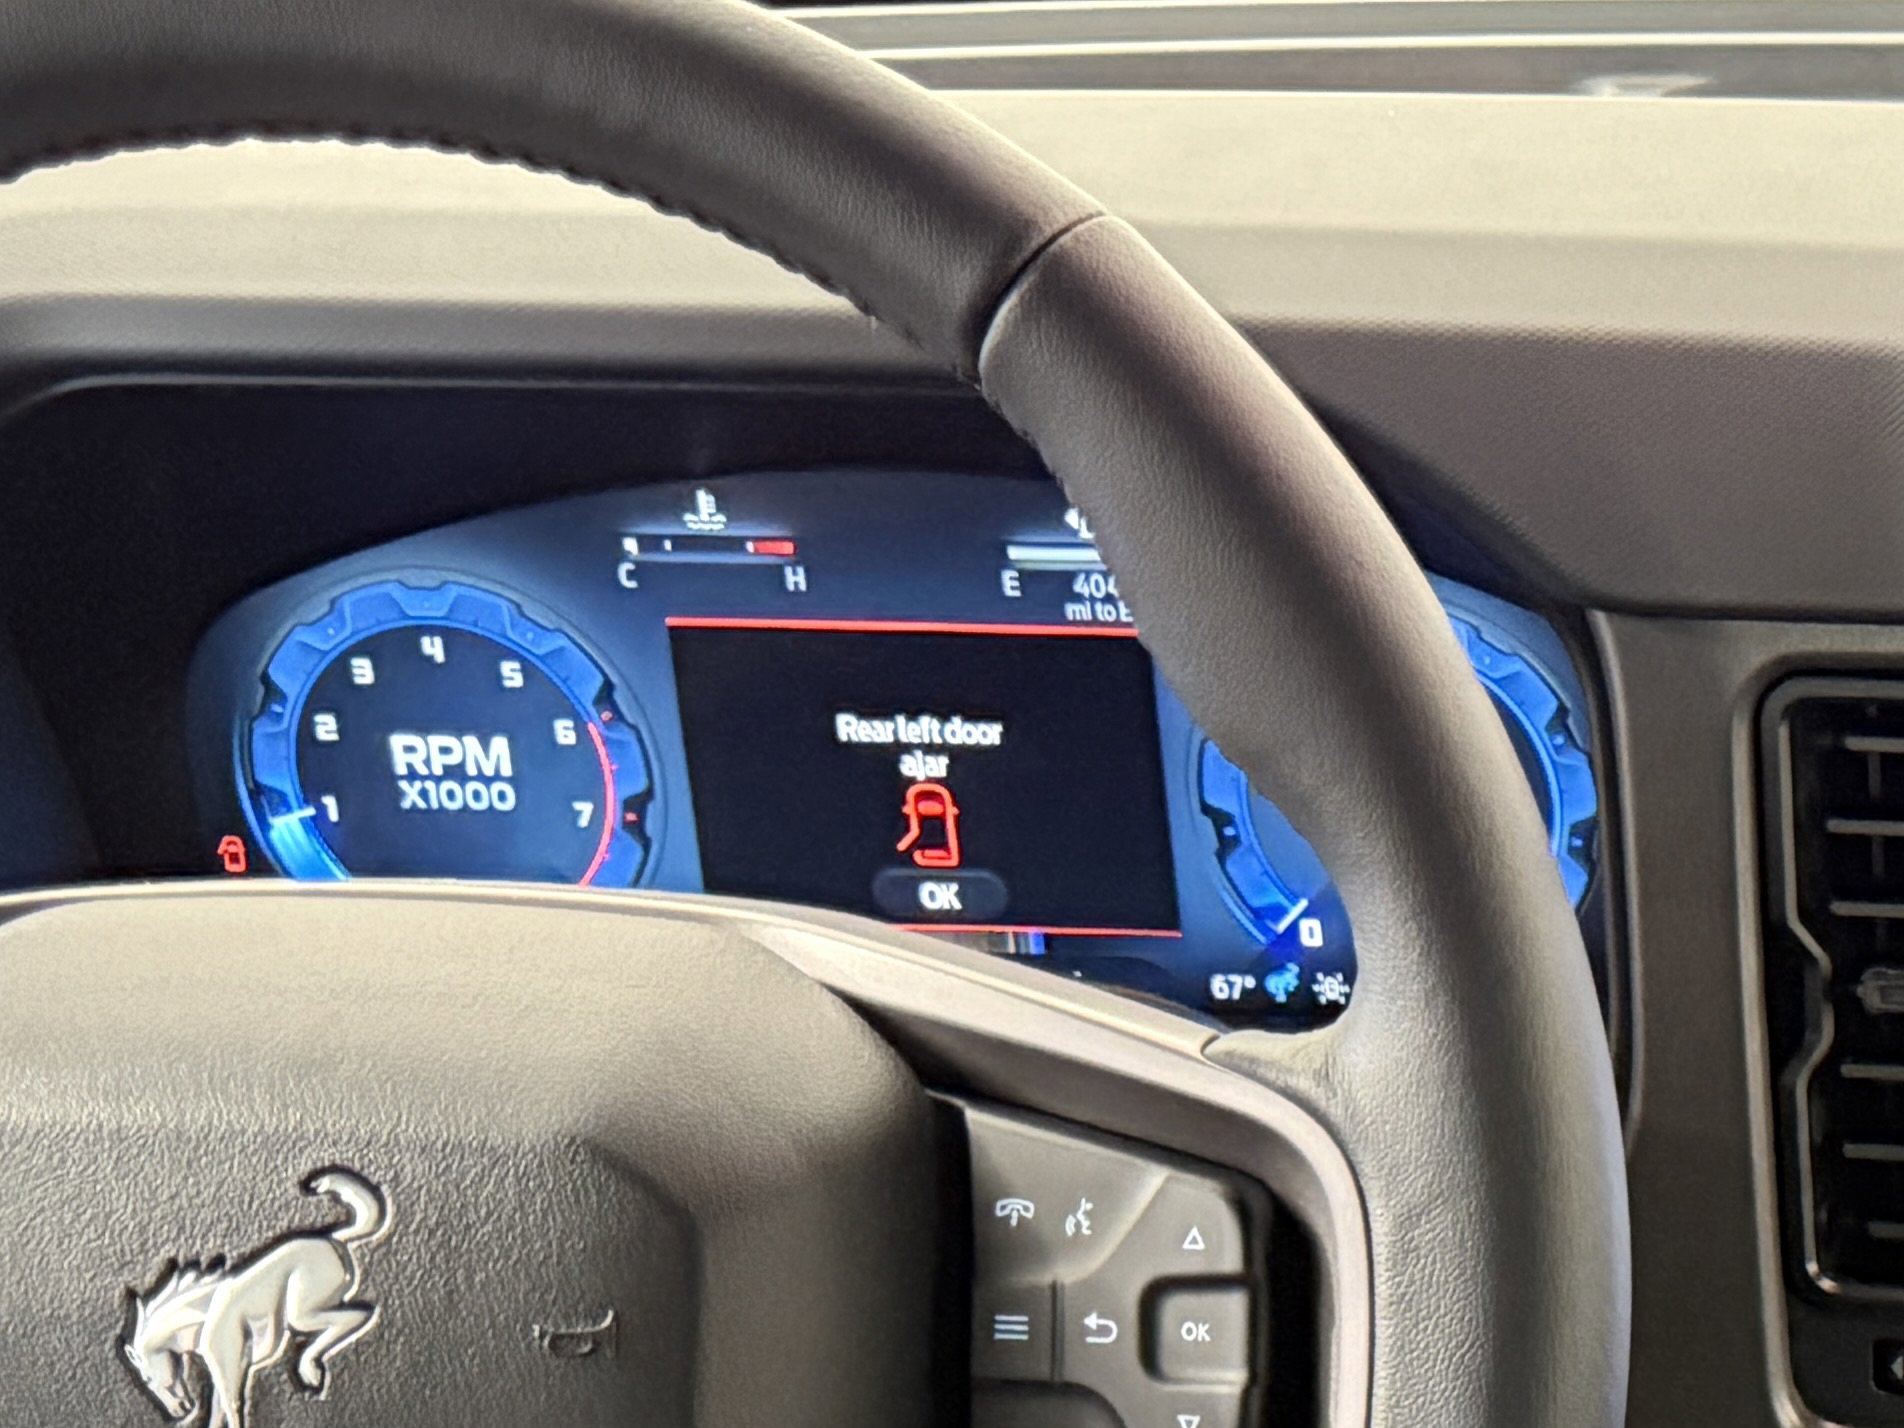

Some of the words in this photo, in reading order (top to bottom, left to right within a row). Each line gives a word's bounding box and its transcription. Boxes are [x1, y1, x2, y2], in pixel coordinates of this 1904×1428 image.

[617, 563, 638, 589] C
[784, 566, 808, 592] H
[1001, 570, 1021, 597] E
[1064, 600, 1092, 621] mi
[1095, 601, 1117, 622] to
[421, 636, 446, 663] 4
[350, 658, 376, 686] 3
[501, 662, 525, 688] 5
[314, 713, 340, 742] 2
[553, 719, 578, 746] 6
[836, 713, 894, 744] Rear
[899, 714, 943, 745] left
[944, 715, 1003, 746] door
[389, 733, 513, 777] RPM
[900, 751, 949, 780] ajar
[321, 795, 340, 822] 1
[399, 781, 516, 812] X1000
[573, 802, 595, 829] 7
[918, 880, 962, 911] OK
[1300, 918, 1323, 947] 0
[1210, 974, 1256, 1000] 67°
[1181, 1321, 1210, 1342] OK
